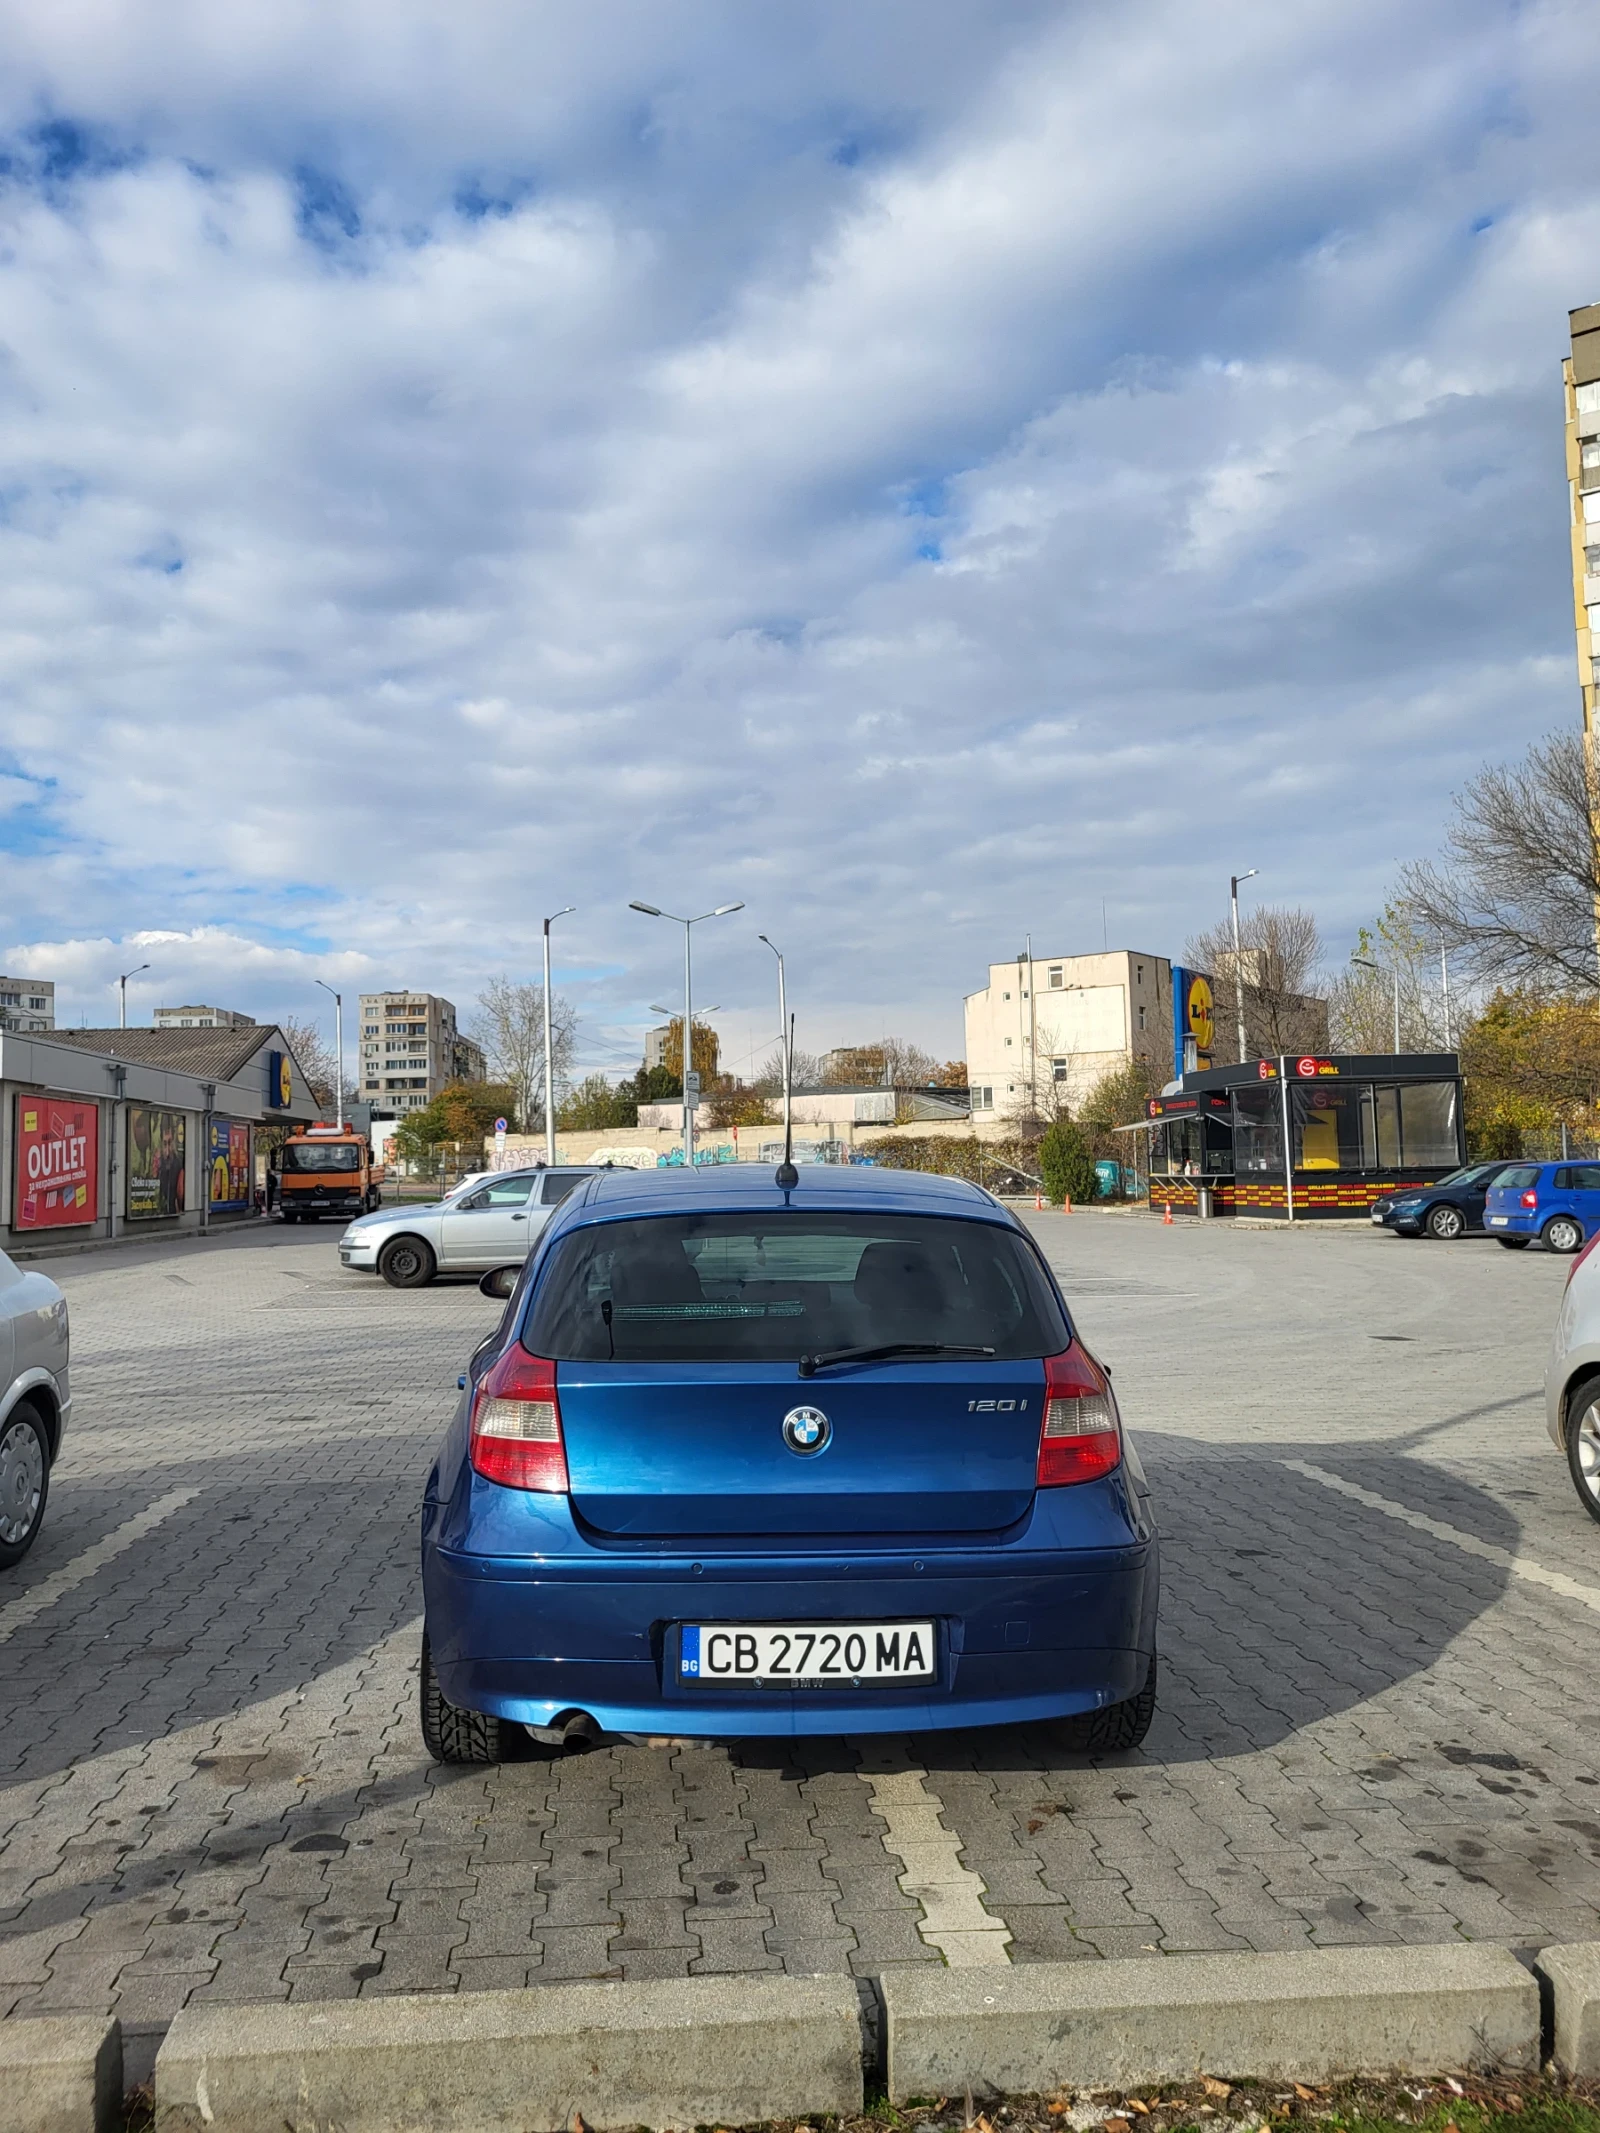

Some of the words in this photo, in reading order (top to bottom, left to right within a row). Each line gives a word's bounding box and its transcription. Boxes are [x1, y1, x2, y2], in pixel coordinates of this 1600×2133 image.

[1319, 1066, 1340, 1075] GRILL
[27, 1136, 87, 1179] OUTLET
[790, 1411, 824, 1425] BMW
[707, 1633, 759, 1674] CB
[769, 1633, 867, 1674] 2720
[876, 1631, 926, 1672] MA
[681, 1659, 698, 1672] BG
[790, 1679, 825, 1688] BMW
